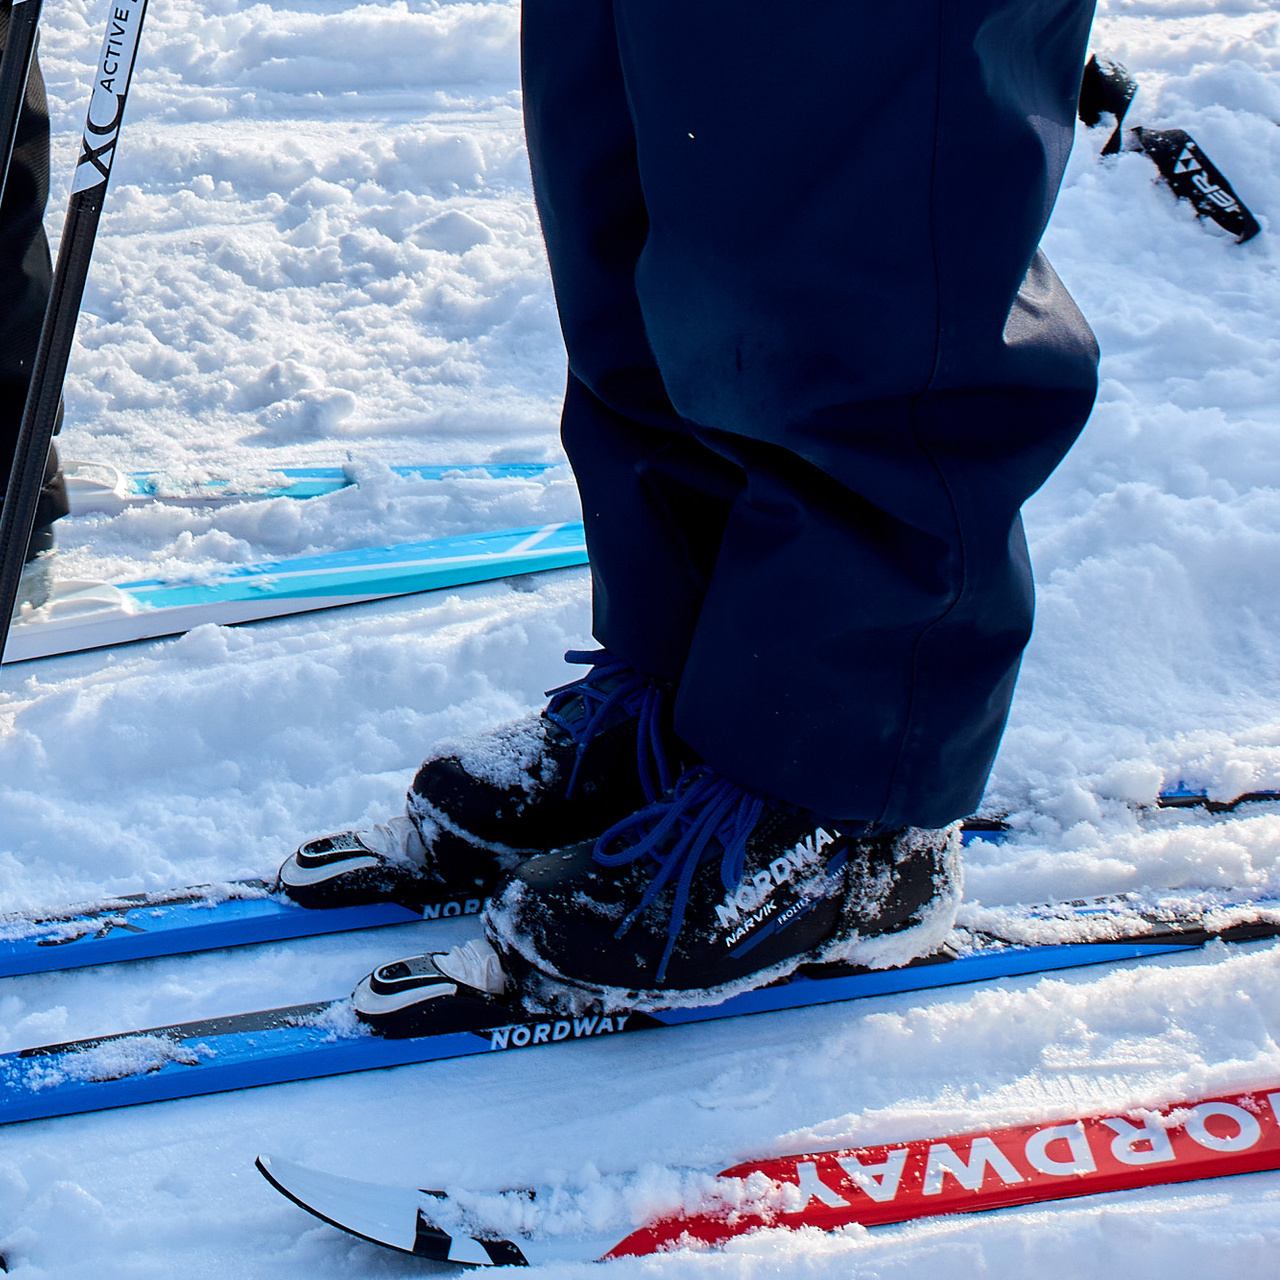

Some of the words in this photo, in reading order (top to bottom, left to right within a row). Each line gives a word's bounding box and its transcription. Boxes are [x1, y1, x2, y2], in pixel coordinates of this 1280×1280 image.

[100, 7, 130, 94] ACTIVE
[725, 899, 778, 948] NARVIK
[490, 1015, 631, 1051] NORDWAY
[784, 1092, 1280, 1213] ORDWAY
